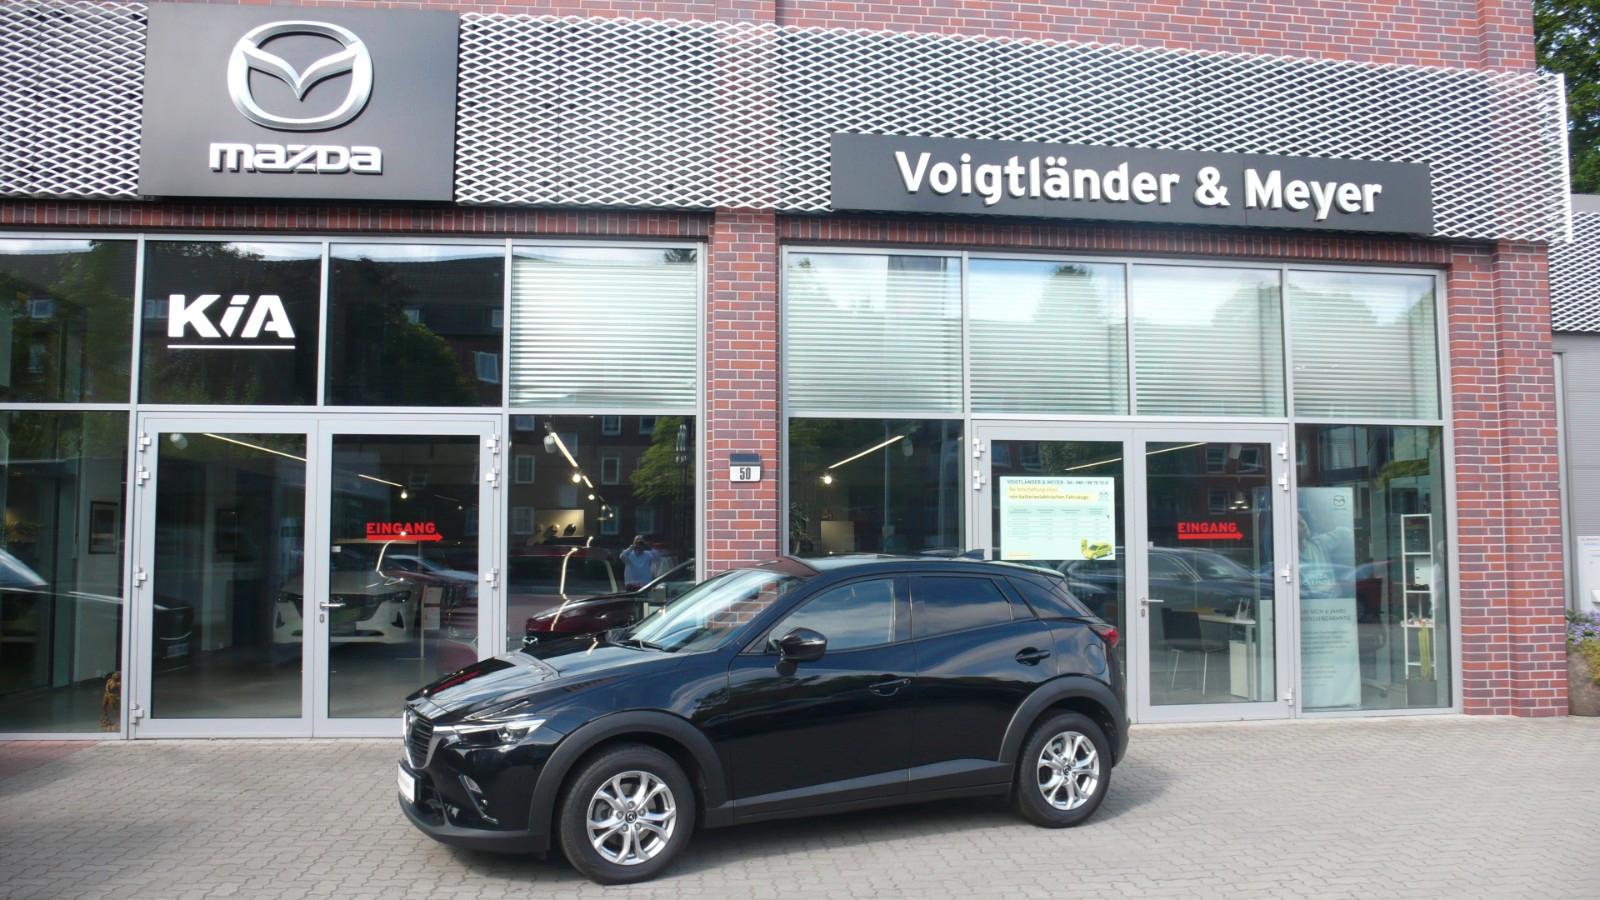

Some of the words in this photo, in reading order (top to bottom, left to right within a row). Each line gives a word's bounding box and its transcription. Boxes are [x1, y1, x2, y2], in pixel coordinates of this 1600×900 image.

[894, 150, 1181, 207] Voigtländer
[1195, 166, 1231, 208] &
[1244, 168, 1383, 221] Meyer
[739, 467, 751, 480] 50
[366, 522, 436, 534] EINGANG
[1177, 522, 1238, 533] EINGANG
